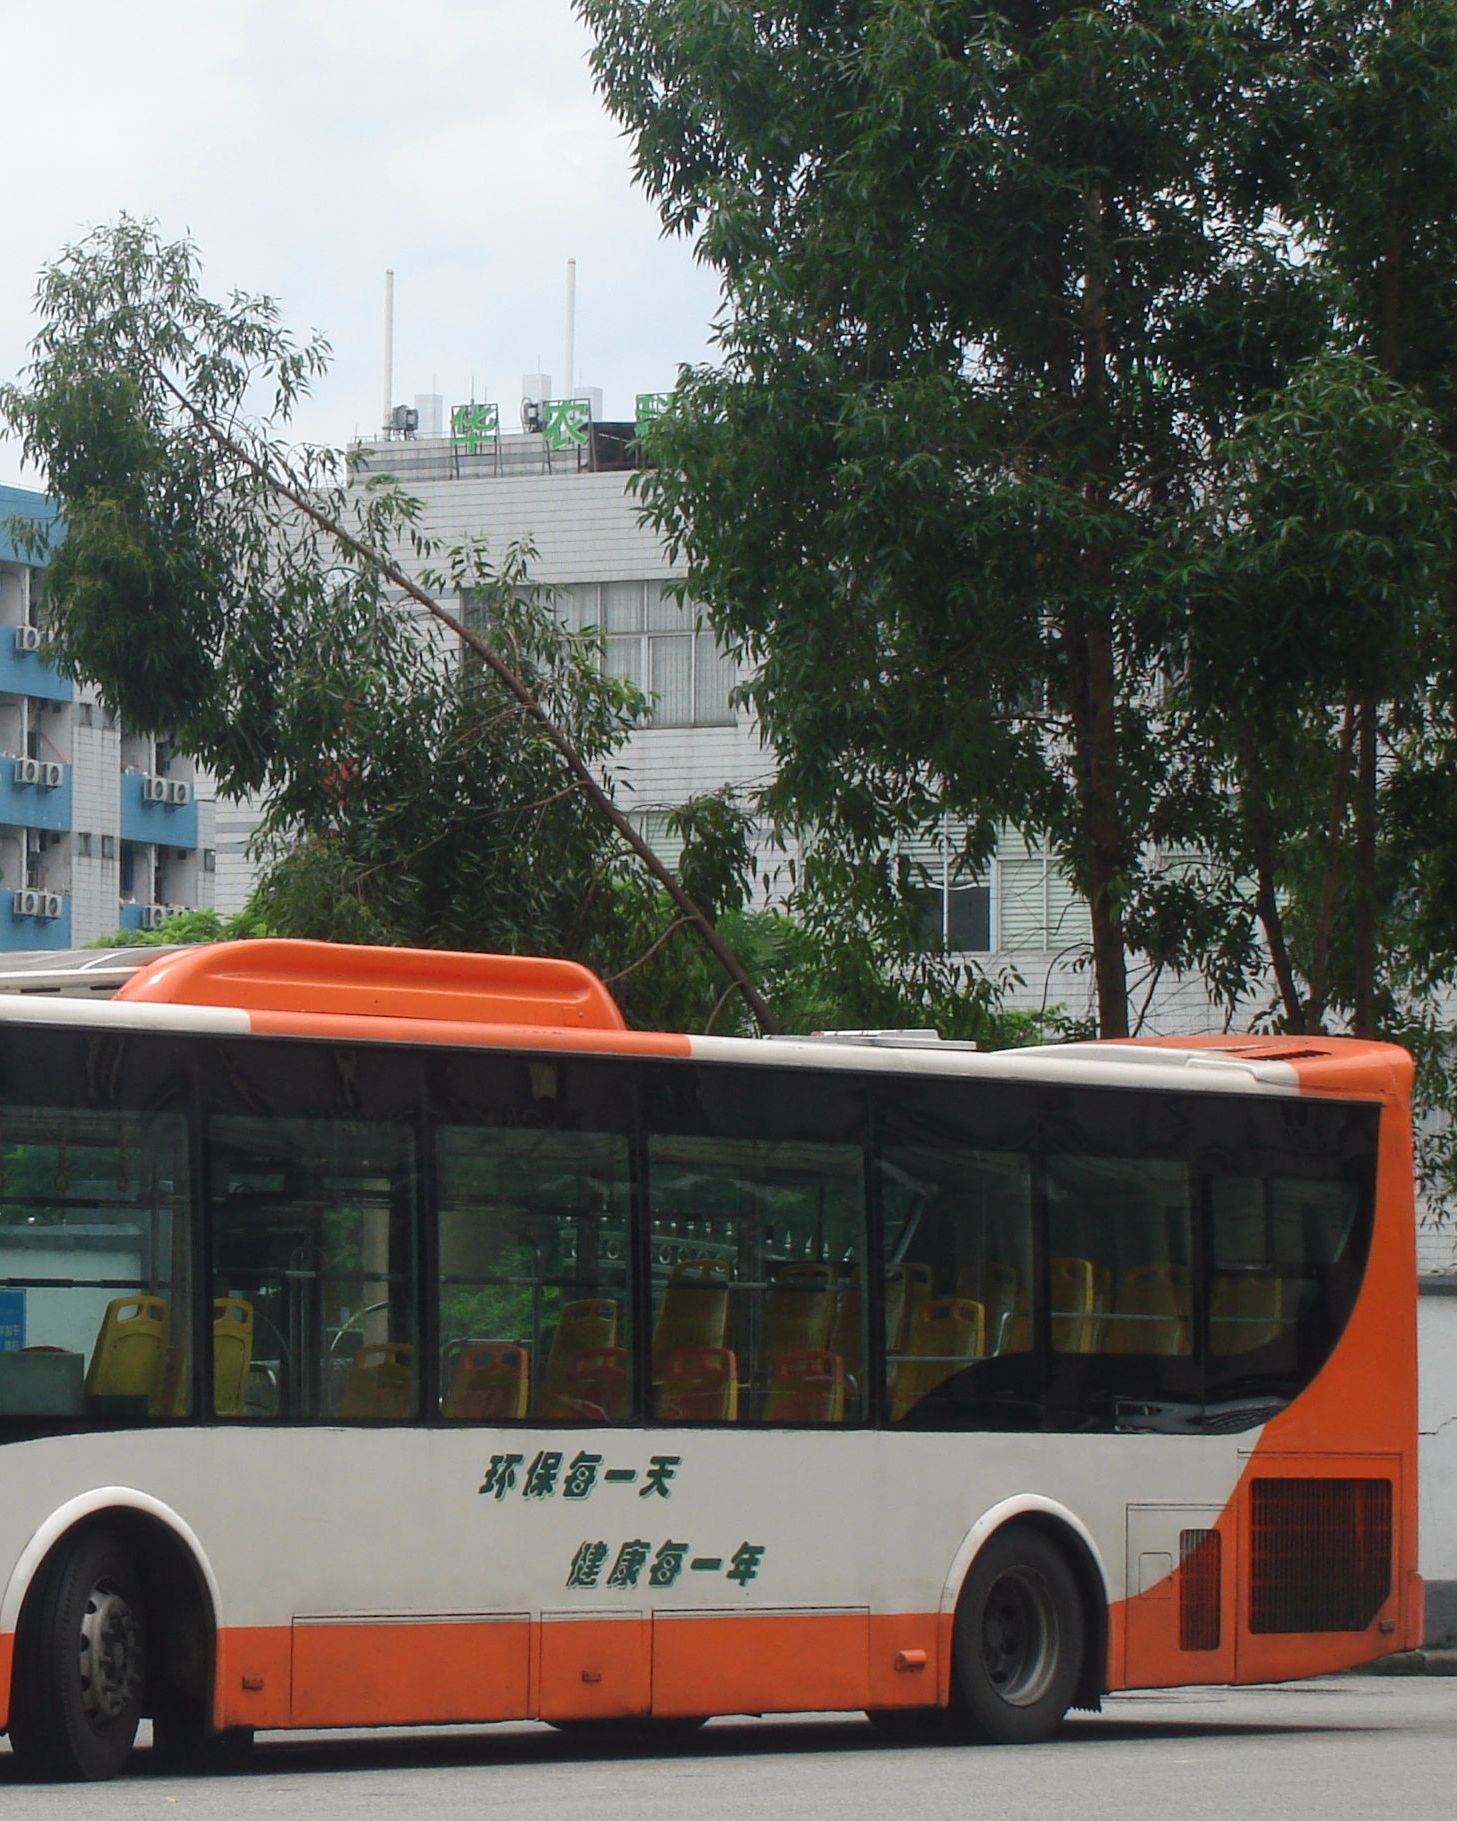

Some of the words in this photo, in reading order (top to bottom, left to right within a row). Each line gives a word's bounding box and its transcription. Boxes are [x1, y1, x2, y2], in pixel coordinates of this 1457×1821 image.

[478, 1450, 682, 1501] 环保每一天
[566, 1539, 765, 1589] 健康每一年
